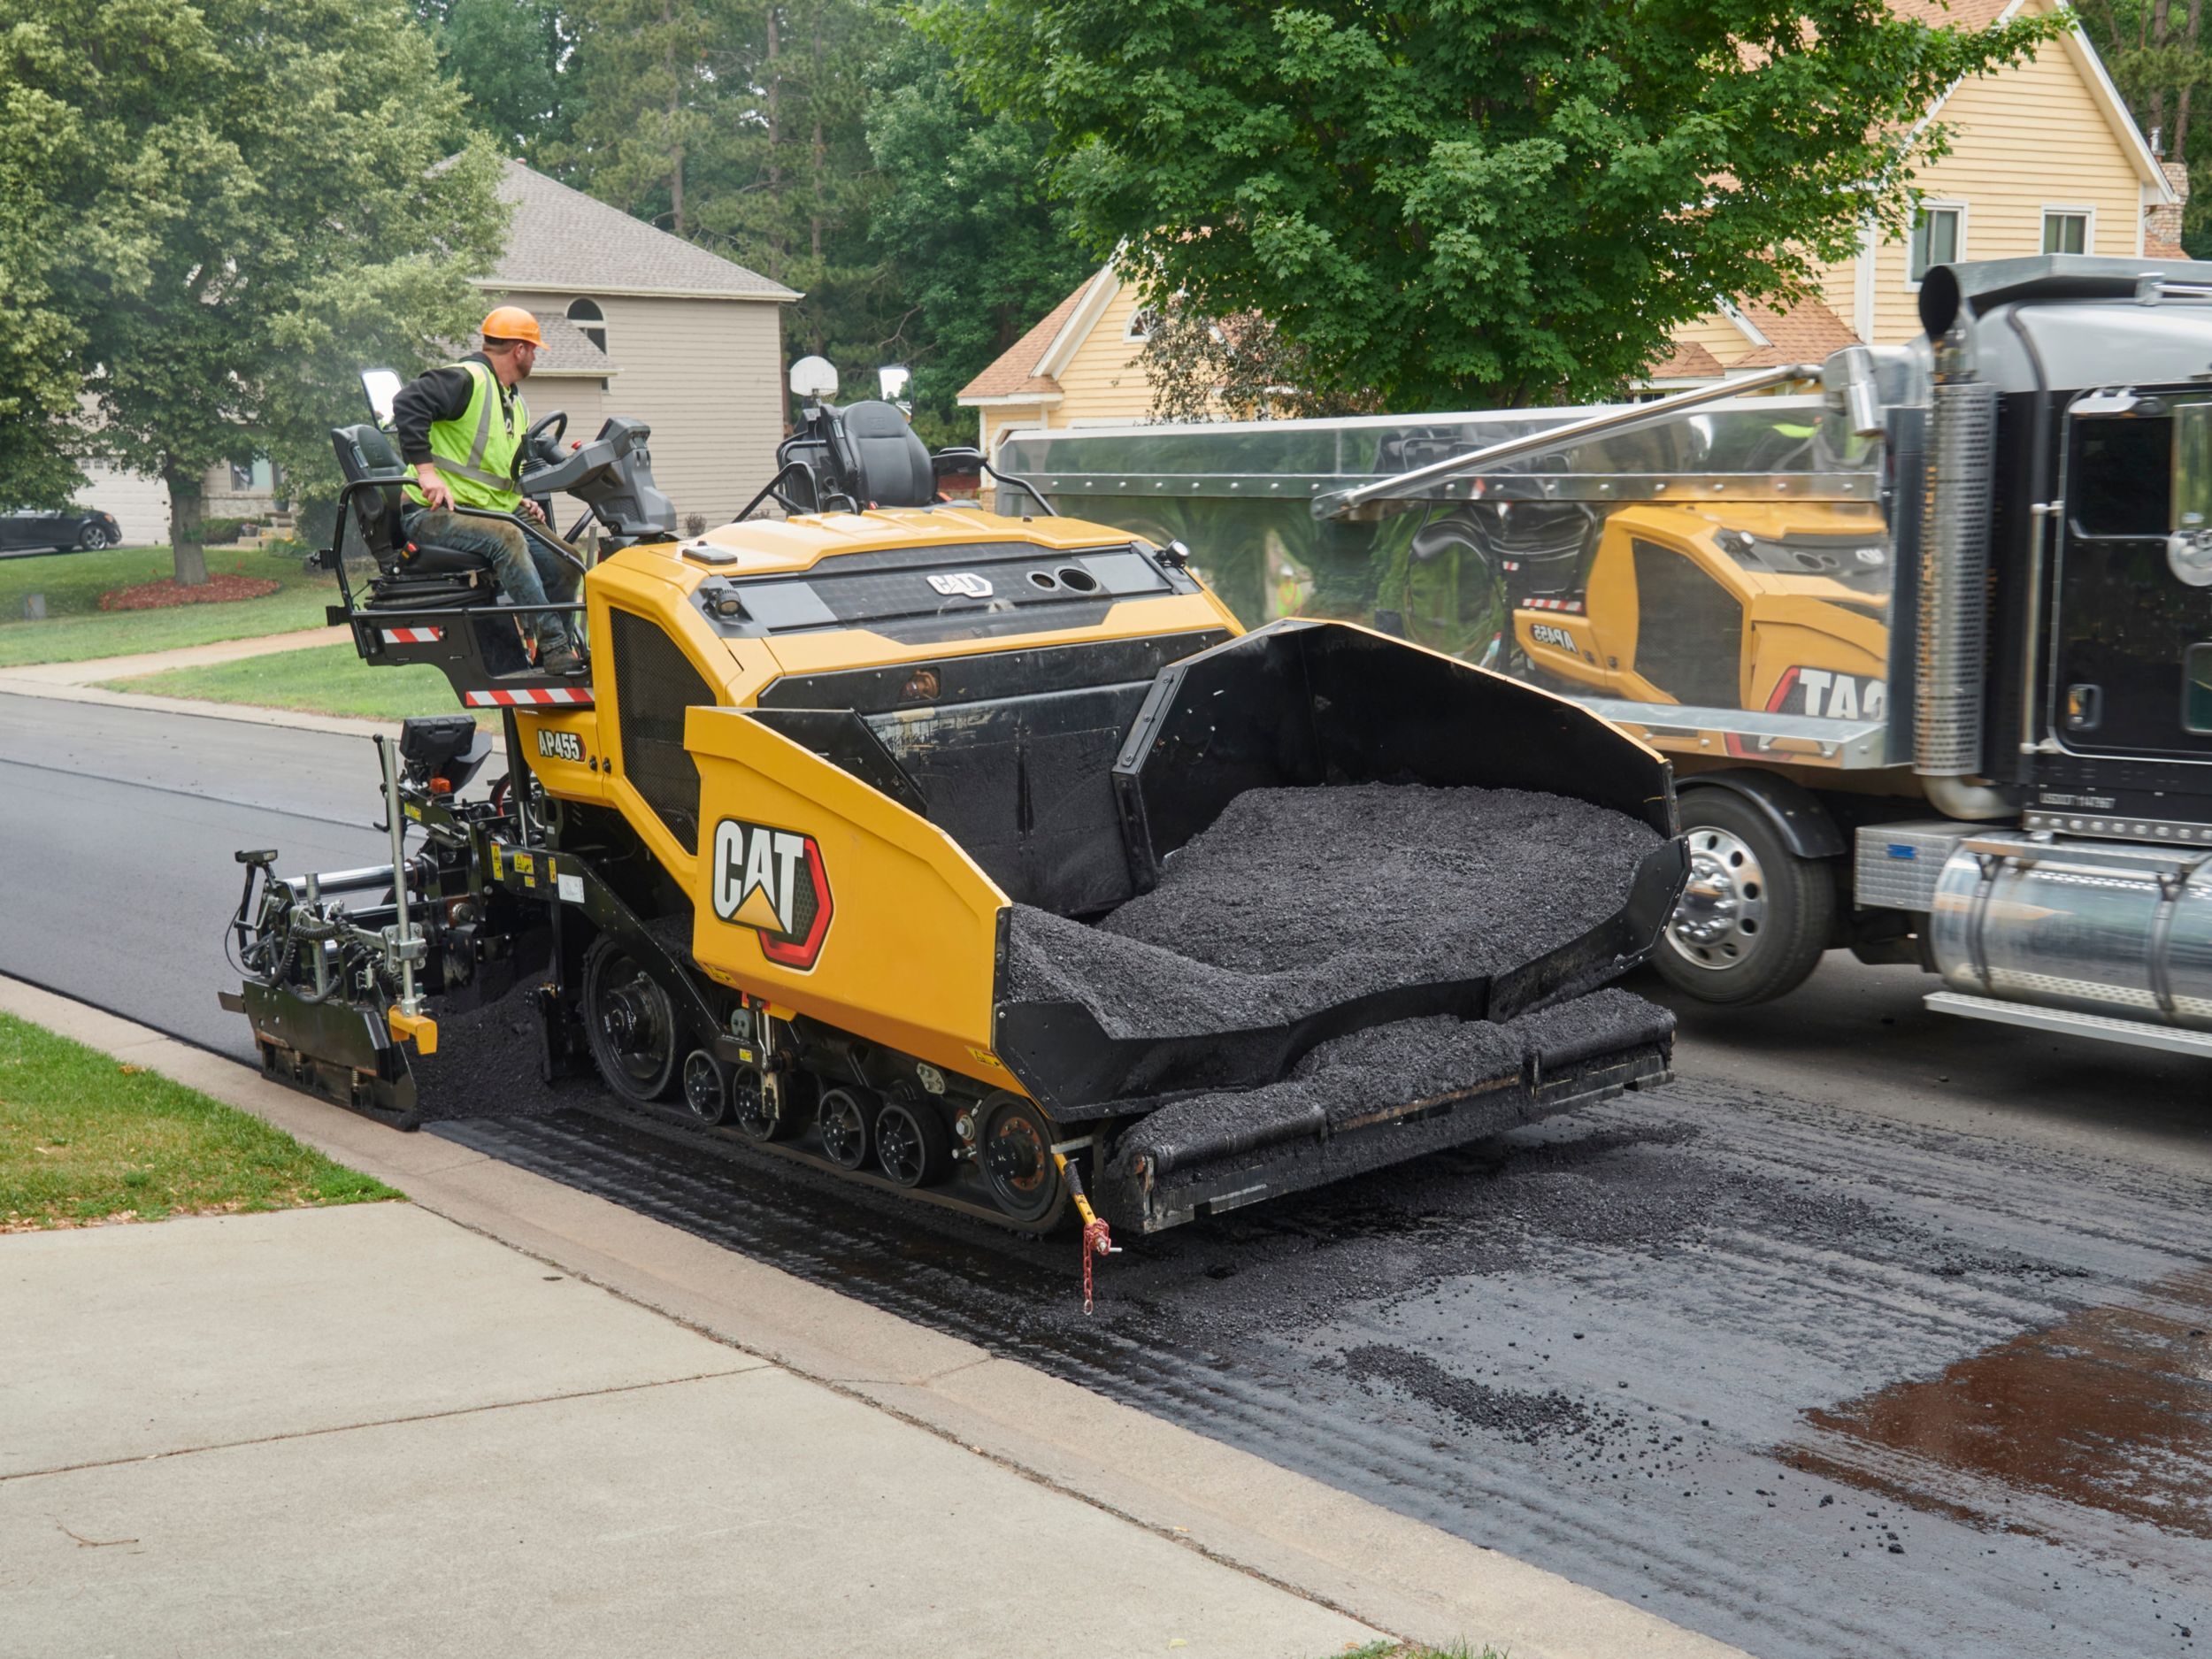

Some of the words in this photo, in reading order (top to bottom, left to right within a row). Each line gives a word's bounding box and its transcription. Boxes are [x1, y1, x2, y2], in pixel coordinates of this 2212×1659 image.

[926, 572, 979, 595] CAT
[538, 730, 580, 760] AP455
[714, 820, 804, 934] CAT
